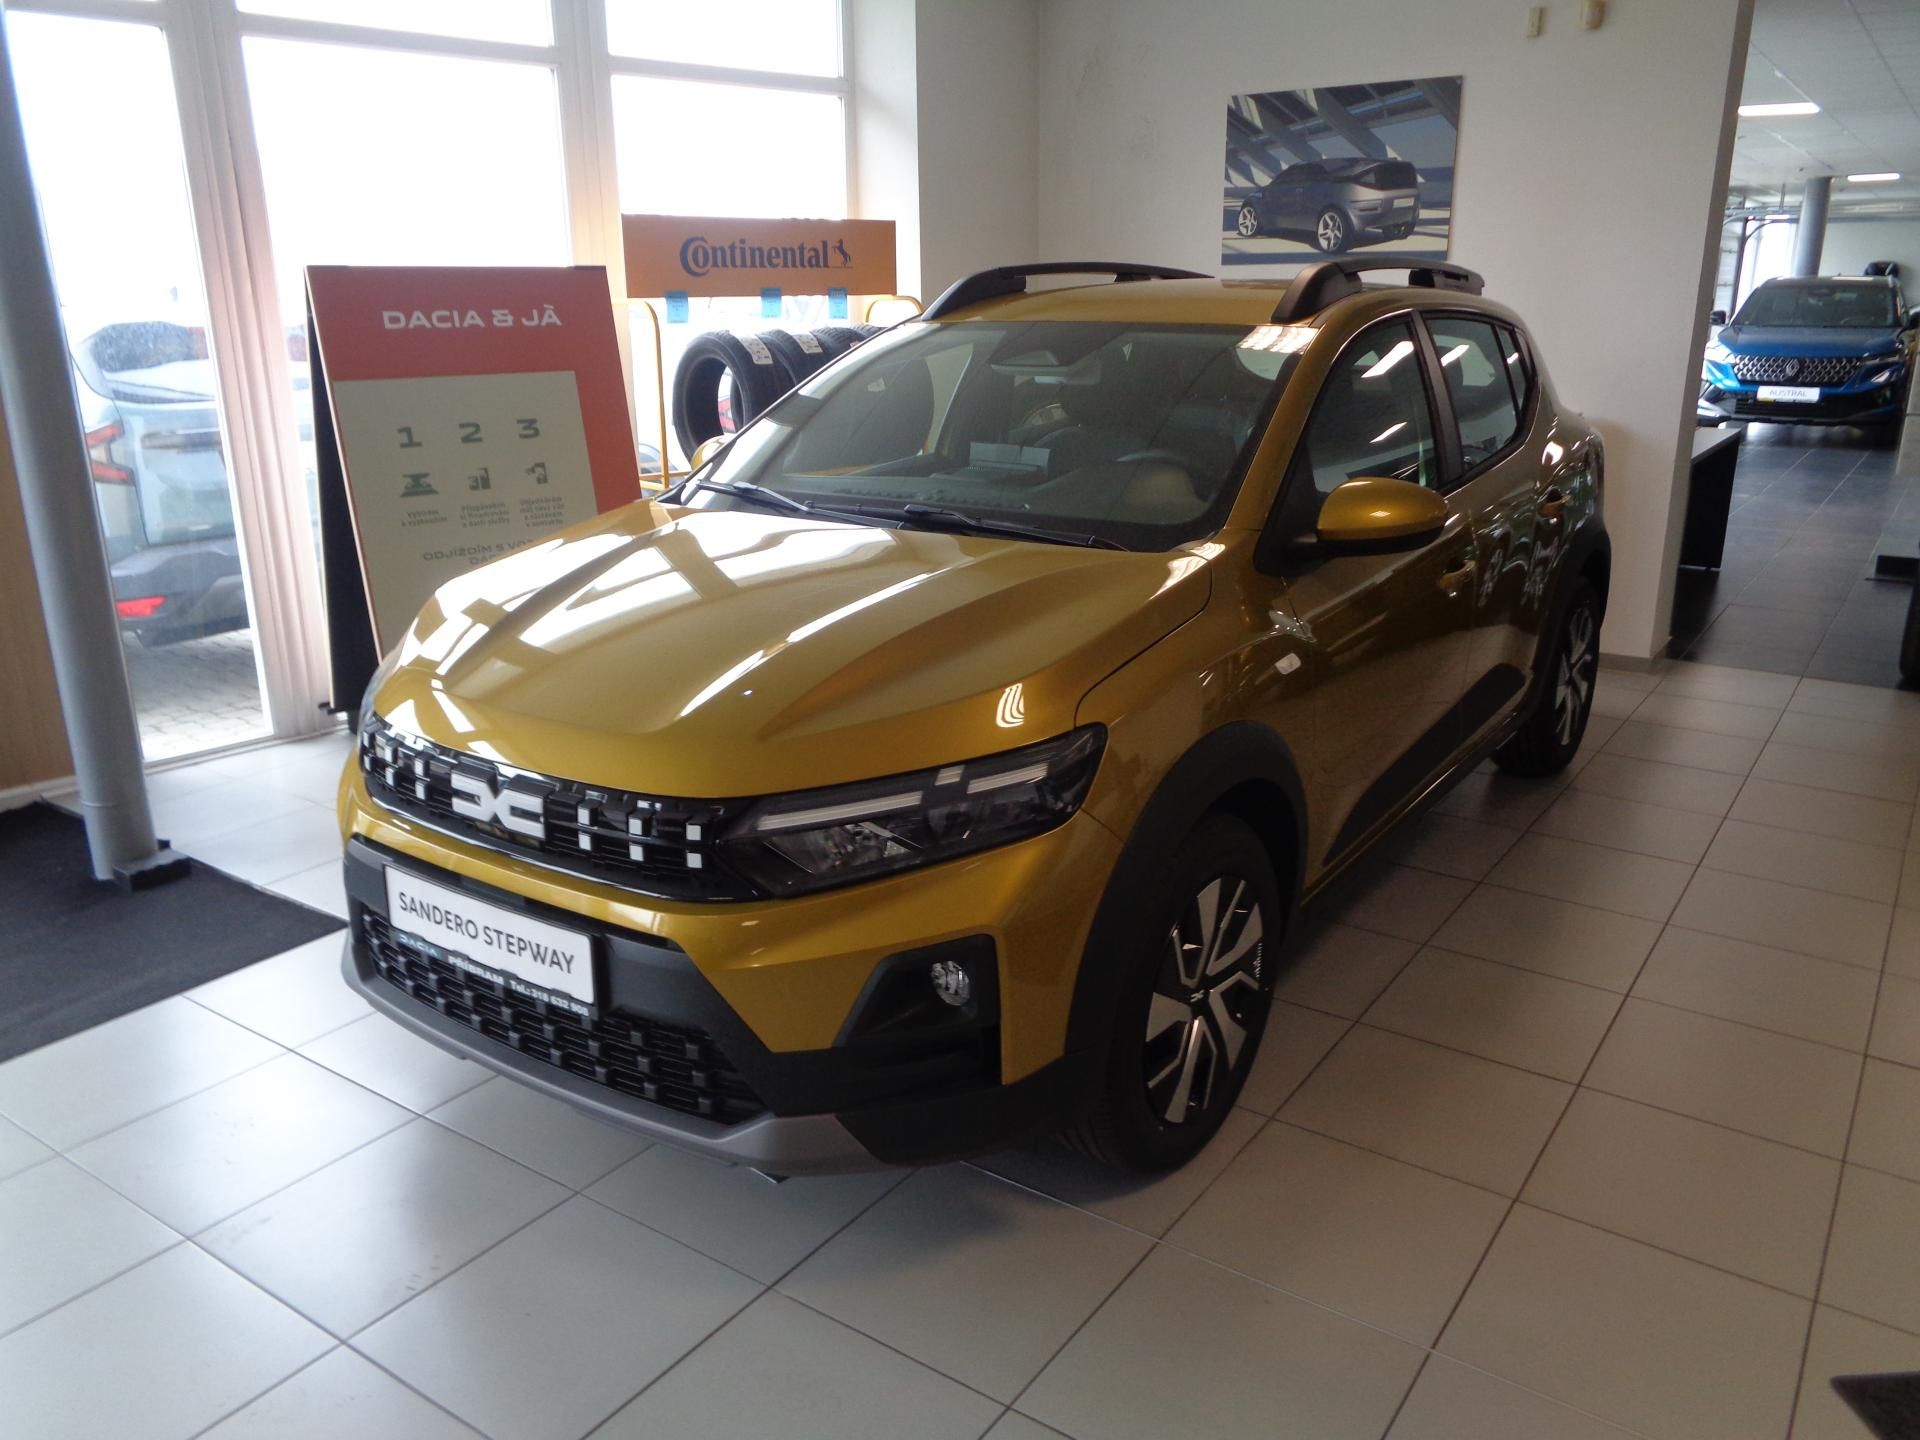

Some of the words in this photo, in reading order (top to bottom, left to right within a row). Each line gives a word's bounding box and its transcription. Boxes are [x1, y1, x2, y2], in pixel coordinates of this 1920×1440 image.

[680, 236, 830, 277] Continental
[382, 310, 485, 329] DACIA
[492, 308, 514, 328] &
[1769, 388, 1808, 398] AUSTRAL
[397, 425, 422, 449] 1
[458, 421, 484, 444] 2
[516, 417, 541, 440] 3
[398, 890, 479, 940] SANDERO
[483, 925, 575, 975] STEPWAY
[399, 932, 439, 958] DACIA
